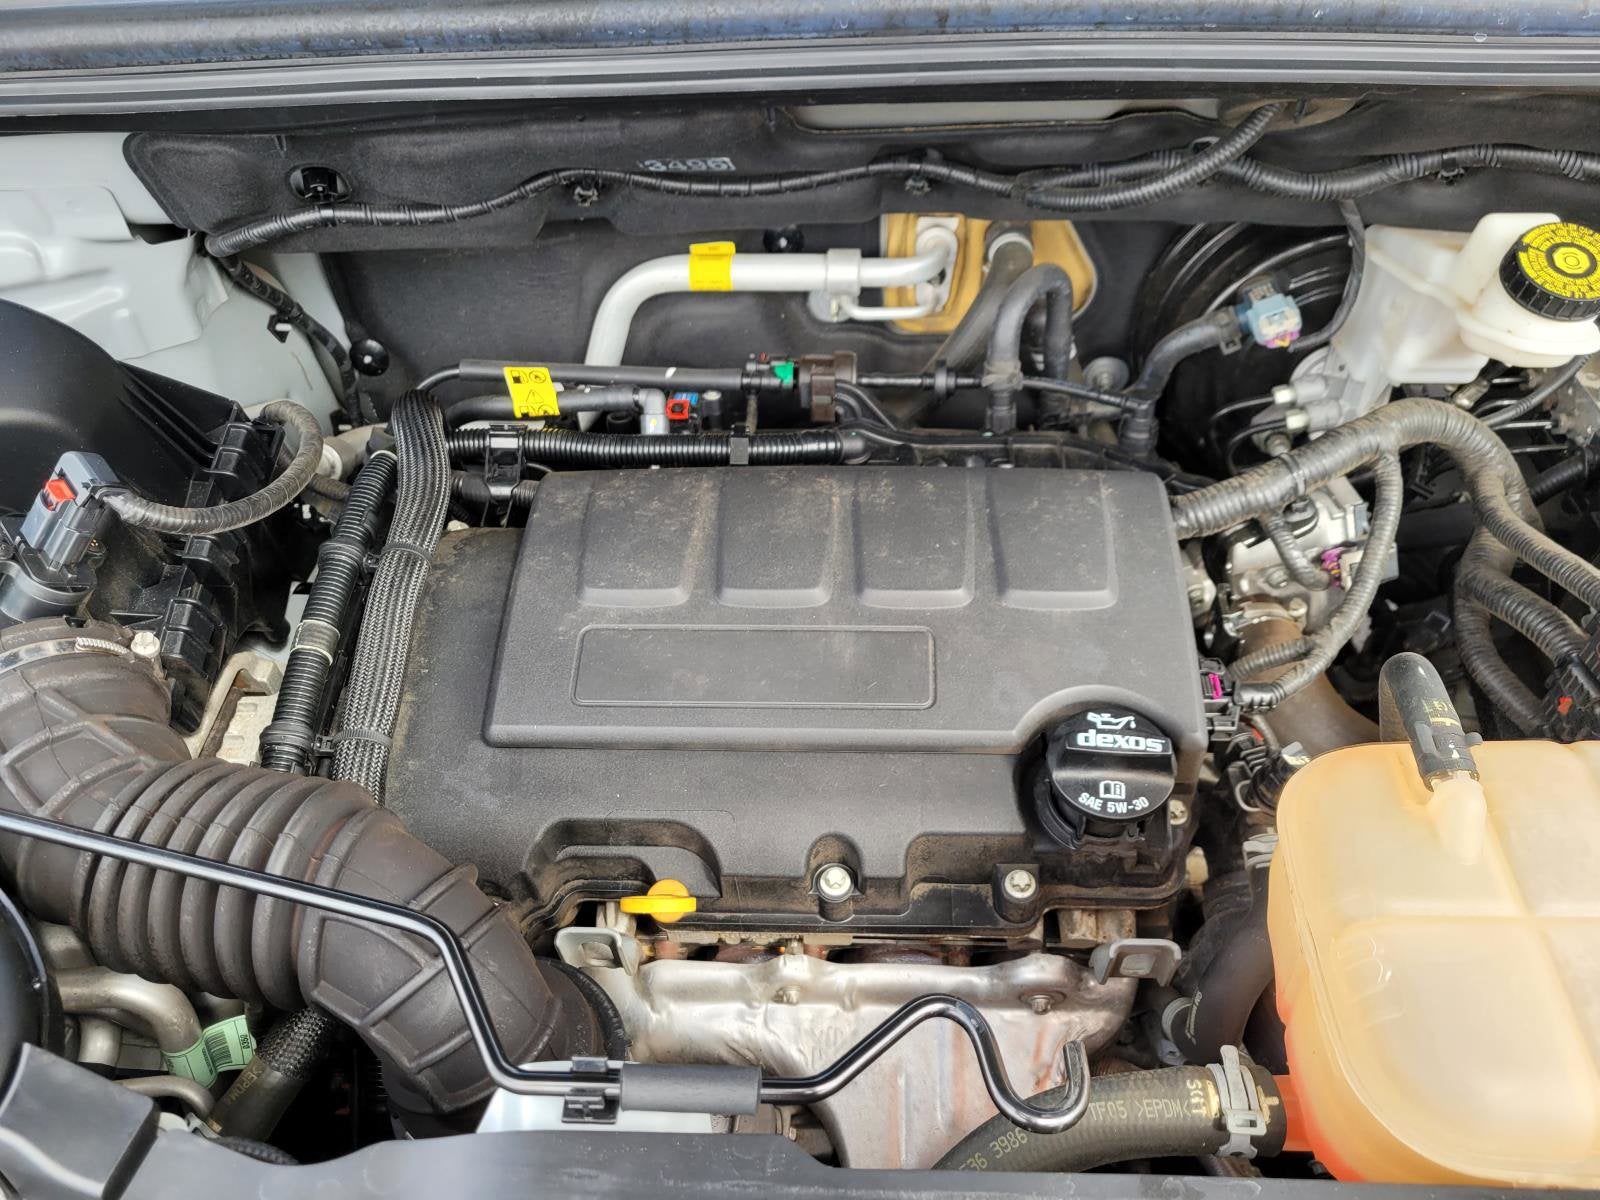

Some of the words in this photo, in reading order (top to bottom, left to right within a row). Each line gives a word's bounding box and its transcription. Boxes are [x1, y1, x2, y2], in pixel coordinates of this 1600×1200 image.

[1077, 729, 1166, 753] dexos
[1078, 792, 1103, 811] SAE
[1106, 796, 1150, 814] 5W-30
[990, 1127, 1028, 1159] 3986
